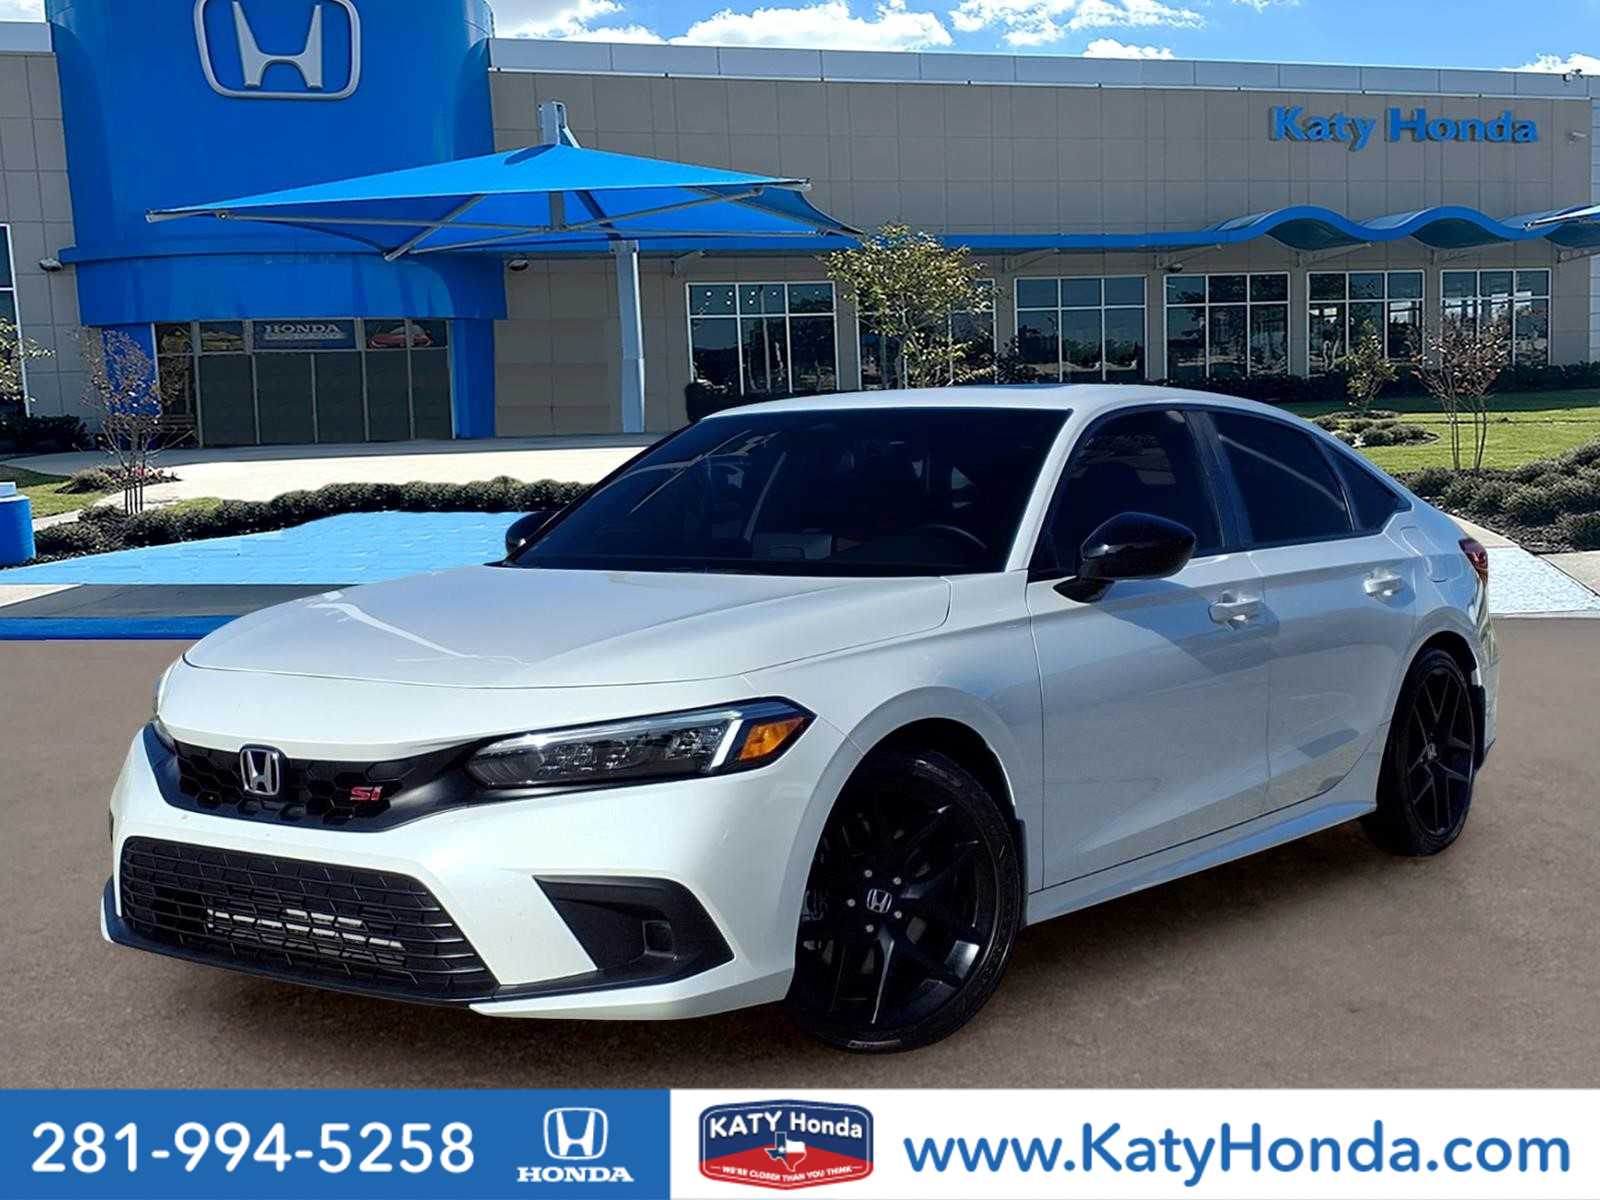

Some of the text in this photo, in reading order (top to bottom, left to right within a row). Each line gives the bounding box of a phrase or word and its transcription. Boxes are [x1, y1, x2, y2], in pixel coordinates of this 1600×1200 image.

[1270, 106, 1538, 151] Katy Honda
[263, 324, 342, 334] HONDA
